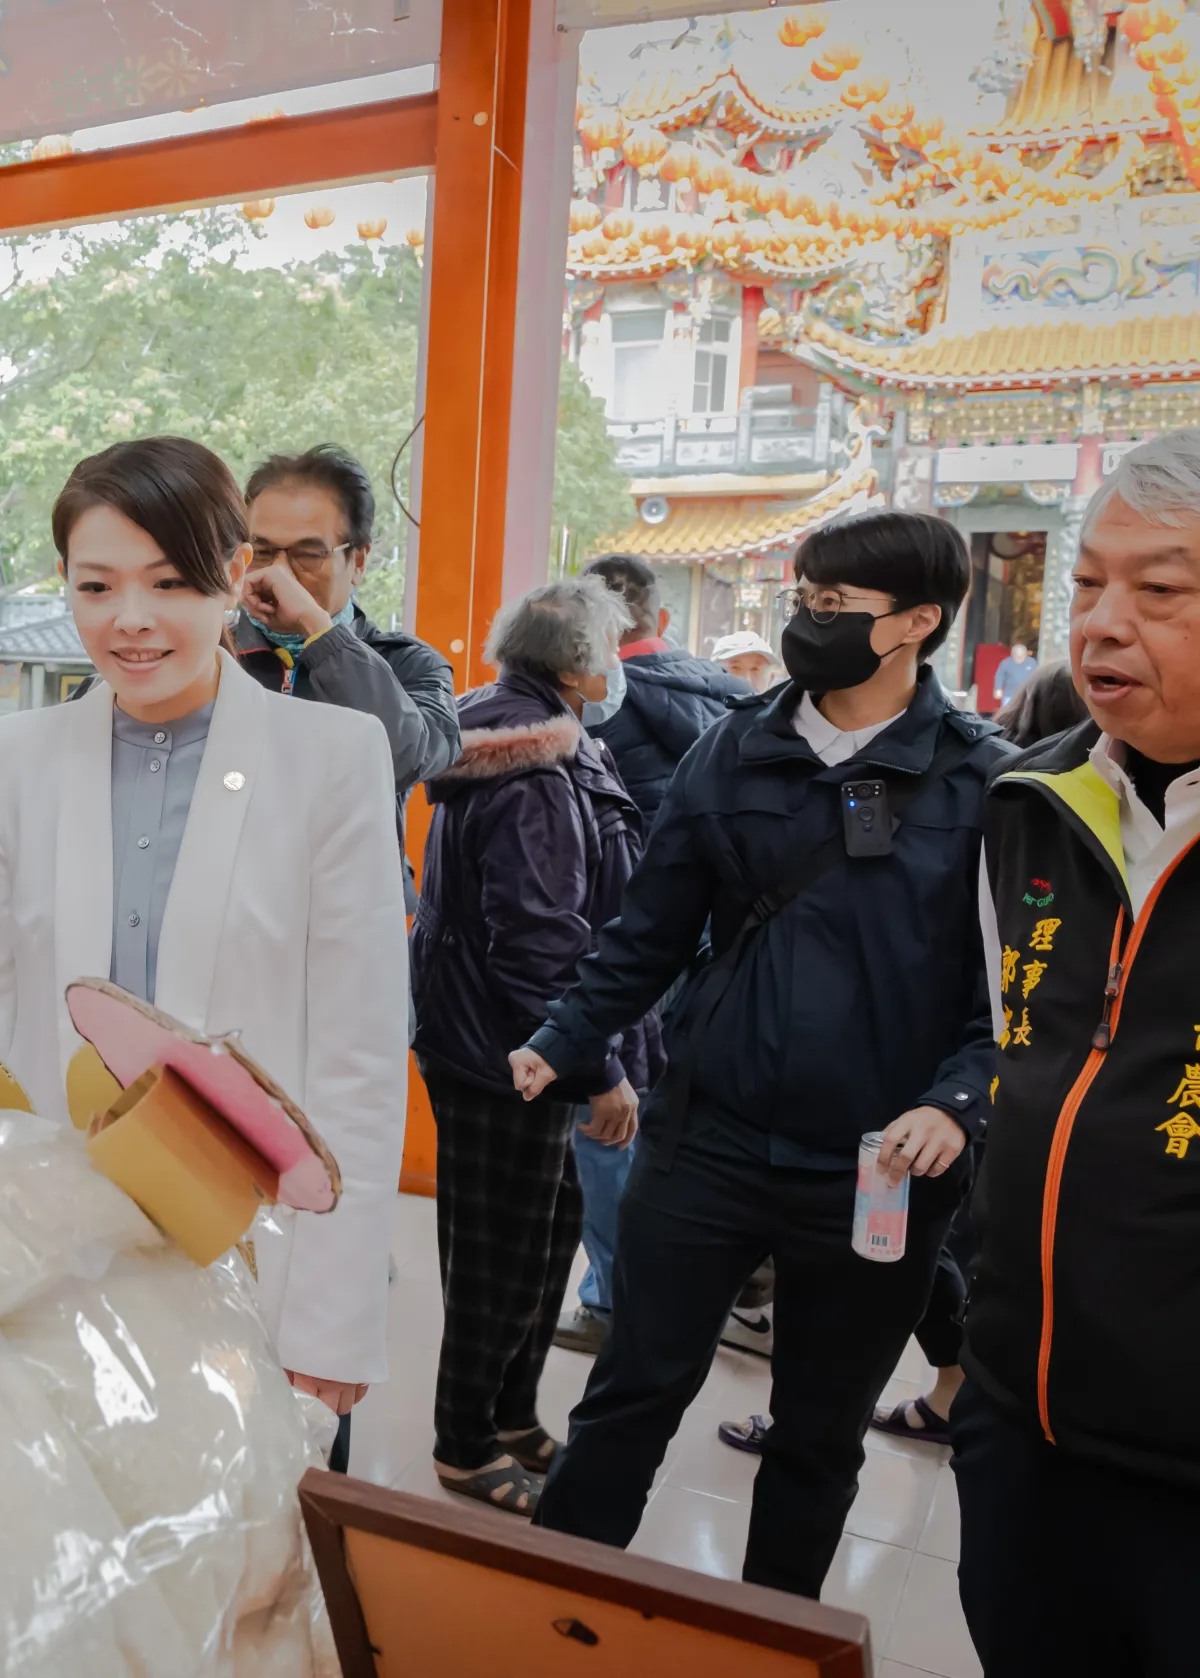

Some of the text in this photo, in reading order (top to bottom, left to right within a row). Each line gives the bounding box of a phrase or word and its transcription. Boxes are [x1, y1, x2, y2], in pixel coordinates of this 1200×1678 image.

[1013, 918, 1061, 1046] 理事長
[1154, 1024, 1200, 1159] 農會
